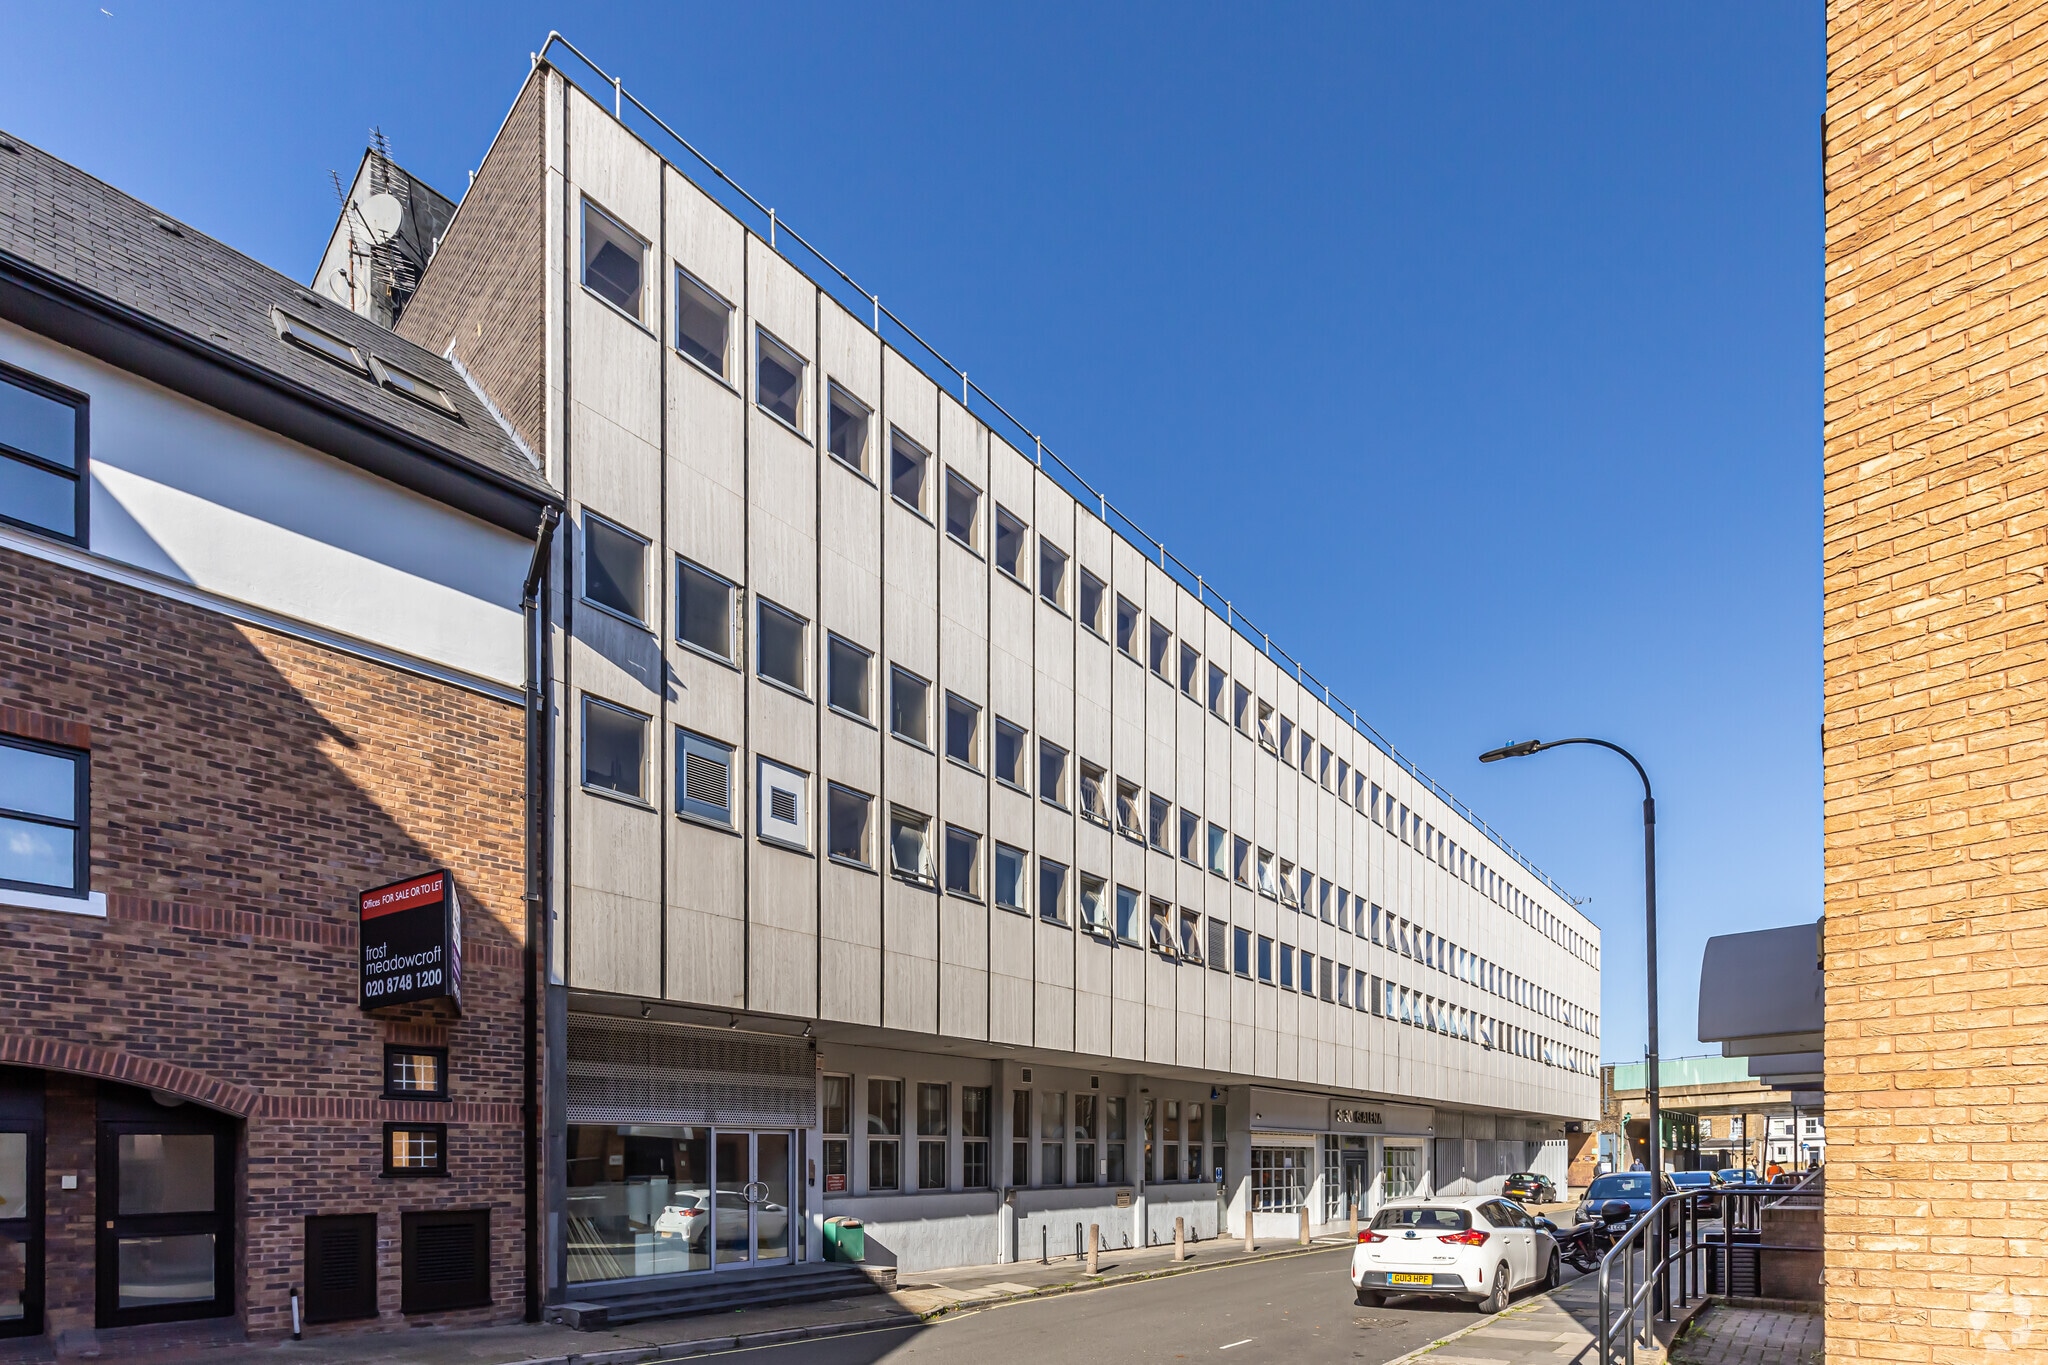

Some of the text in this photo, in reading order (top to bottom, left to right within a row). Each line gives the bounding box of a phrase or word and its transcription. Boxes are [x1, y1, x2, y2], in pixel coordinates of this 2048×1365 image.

[363, 880, 443, 910] Offices FOR SALE OR TO LET
[366, 942, 387, 962] frost
[366, 945, 442, 976] meadowcroft
[365, 968, 442, 997] 020 8748 1200
[1394, 1274, 1429, 1283] GU13 HPF
